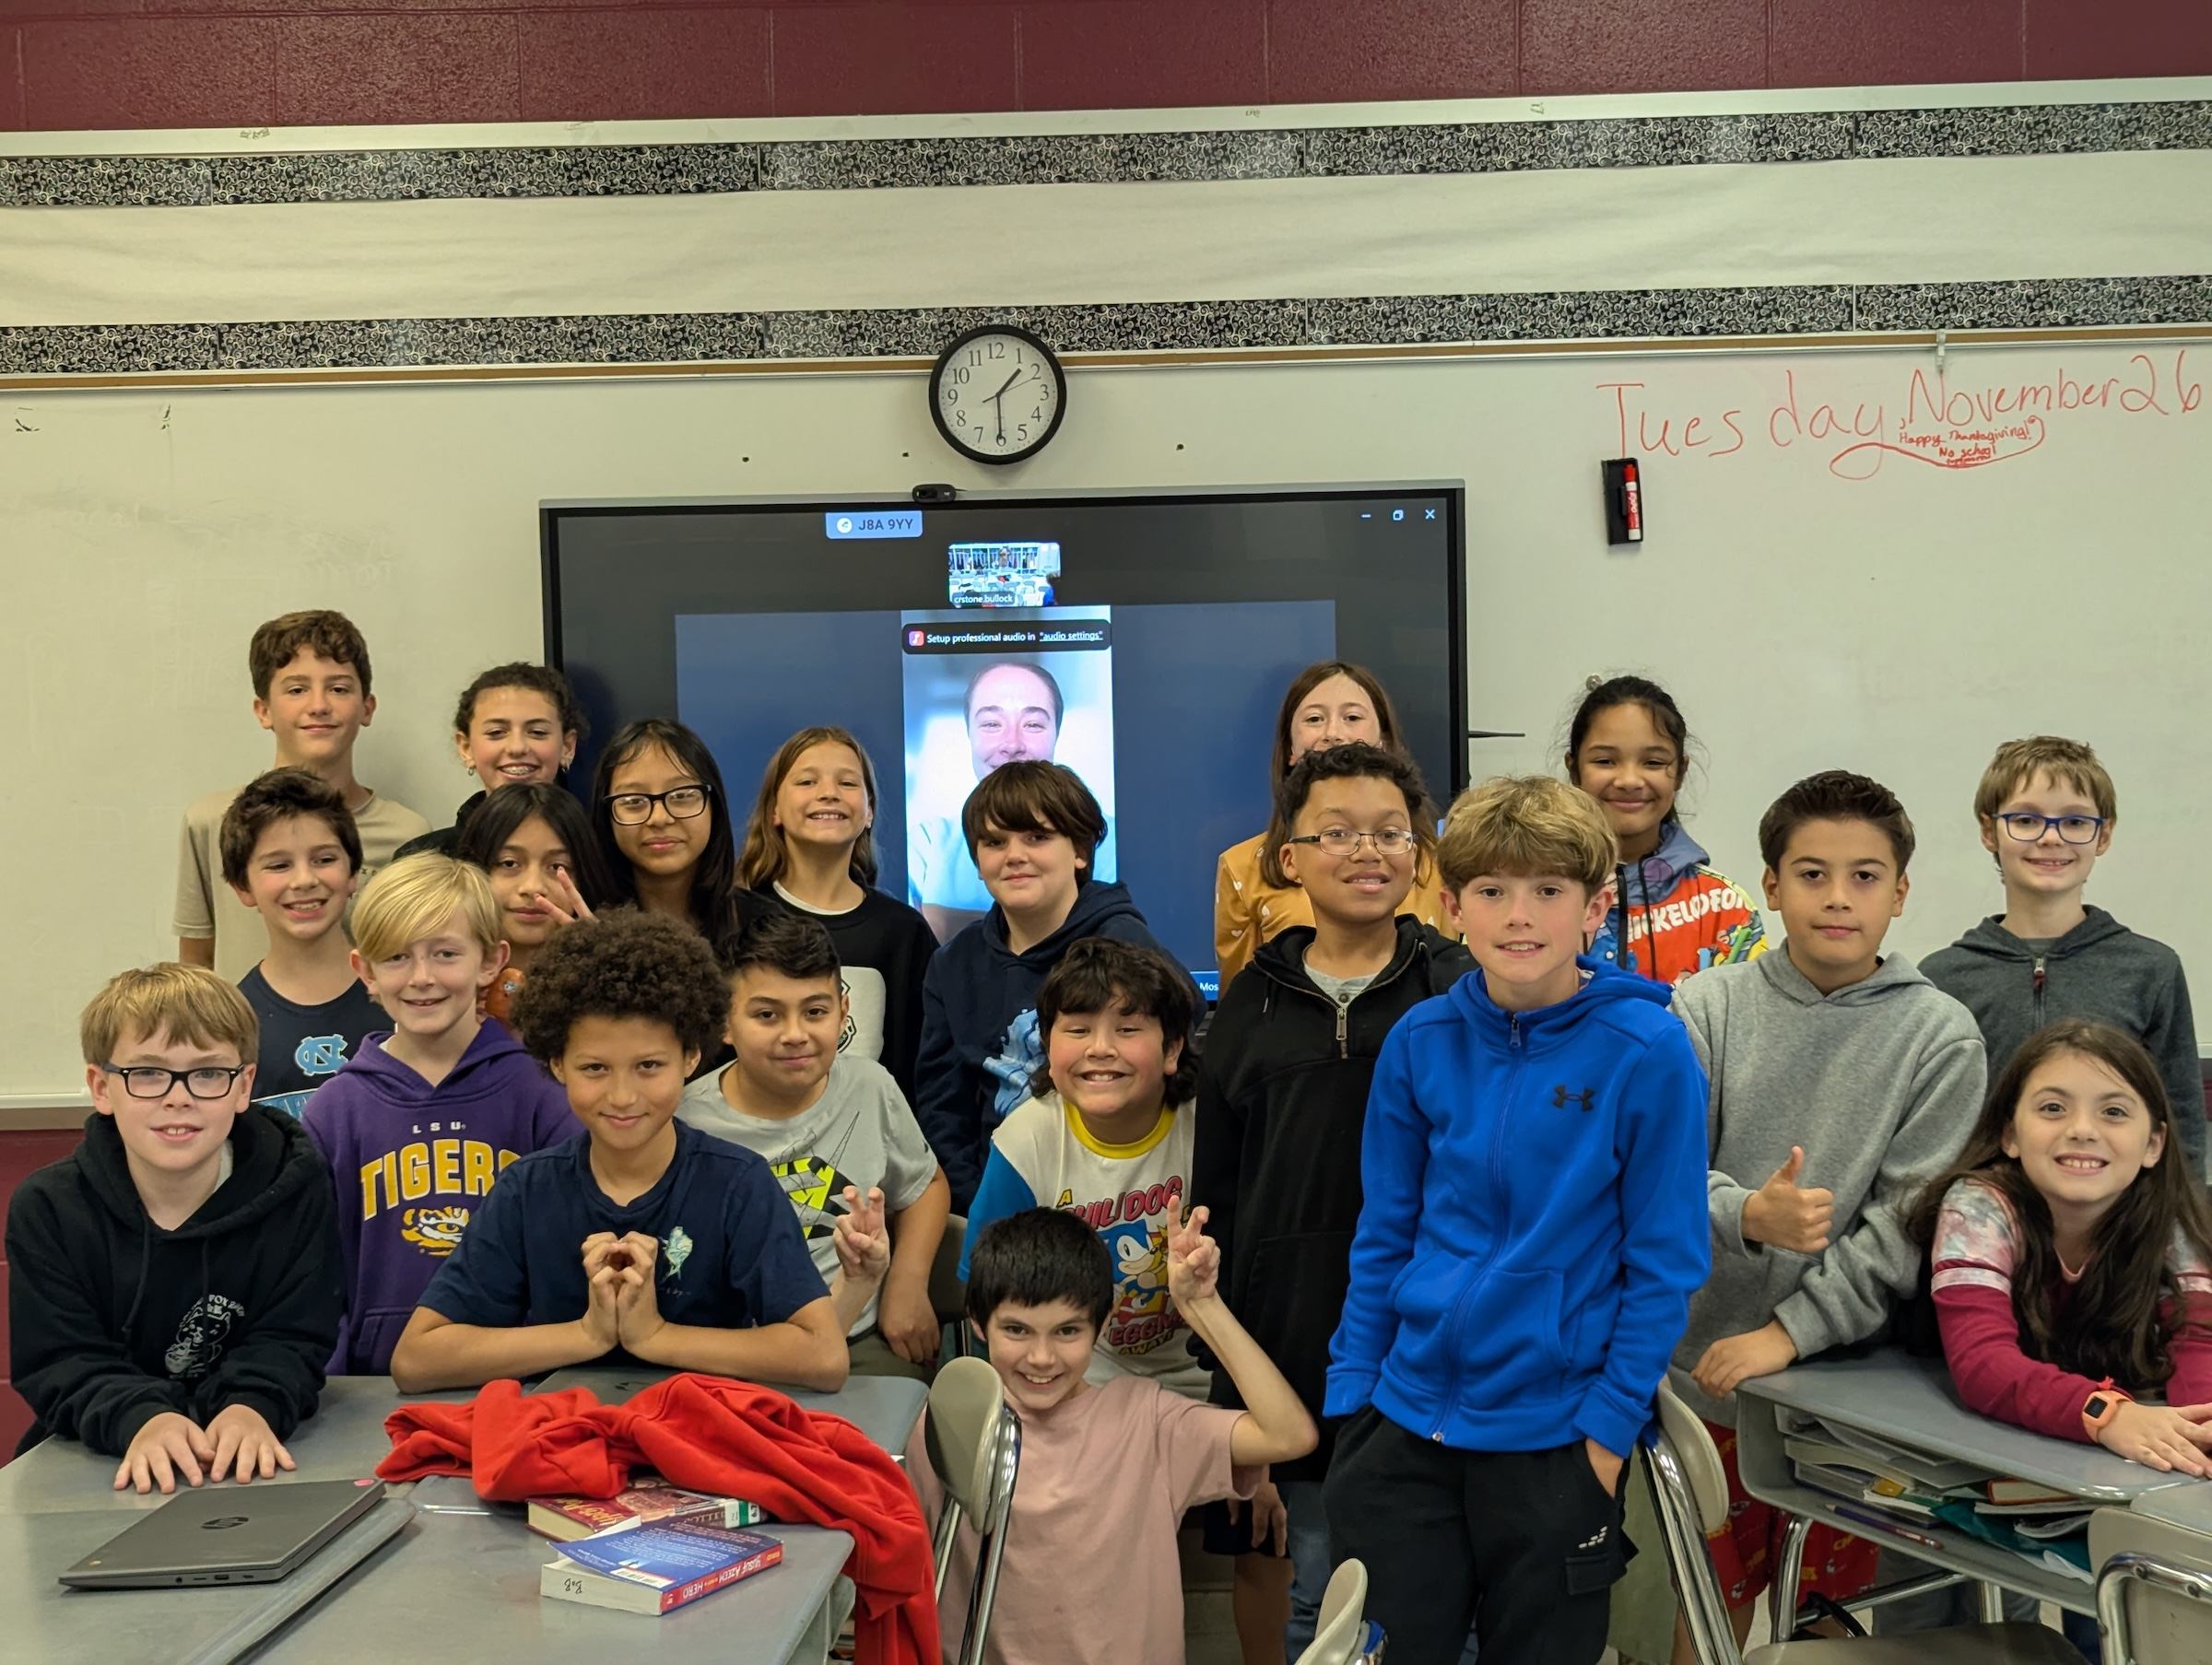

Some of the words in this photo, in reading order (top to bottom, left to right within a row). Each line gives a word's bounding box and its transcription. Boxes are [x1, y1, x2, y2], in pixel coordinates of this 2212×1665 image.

[969, 349, 982, 367] 11
[988, 342, 1005, 359] 12
[1016, 347, 1023, 364] 1
[953, 367, 970, 384] 10
[1030, 363, 1041, 380] 2
[1040, 383, 1049, 401] 3
[1910, 369, 2119, 426] November
[2121, 349, 2201, 415] 26
[947, 389, 959, 405] 9
[956, 410, 966, 427] 8
[1030, 406, 1042, 422] 4
[973, 427, 983, 442] 7
[995, 430, 1006, 446] 6
[1017, 424, 1028, 441] 5
[1900, 431, 1946, 446] Happy
[1939, 446, 1955, 458] No
[858, 520, 884, 530] J8A
[888, 519, 913, 530] 9YY
[954, 594, 1013, 604] crstone.bullock
[926, 633, 951, 644] Setup
[953, 633, 1001, 644] professional
[1003, 632, 1026, 642] audio
[1028, 633, 1036, 641] in
[1200, 982, 1218, 991] Mos
[1056, 1189, 1072, 1208] A
[1065, 1192, 1126, 1230] HILI
[1124, 1176, 1182, 1221] DOG
[682, 1581, 703, 1599] HERO
